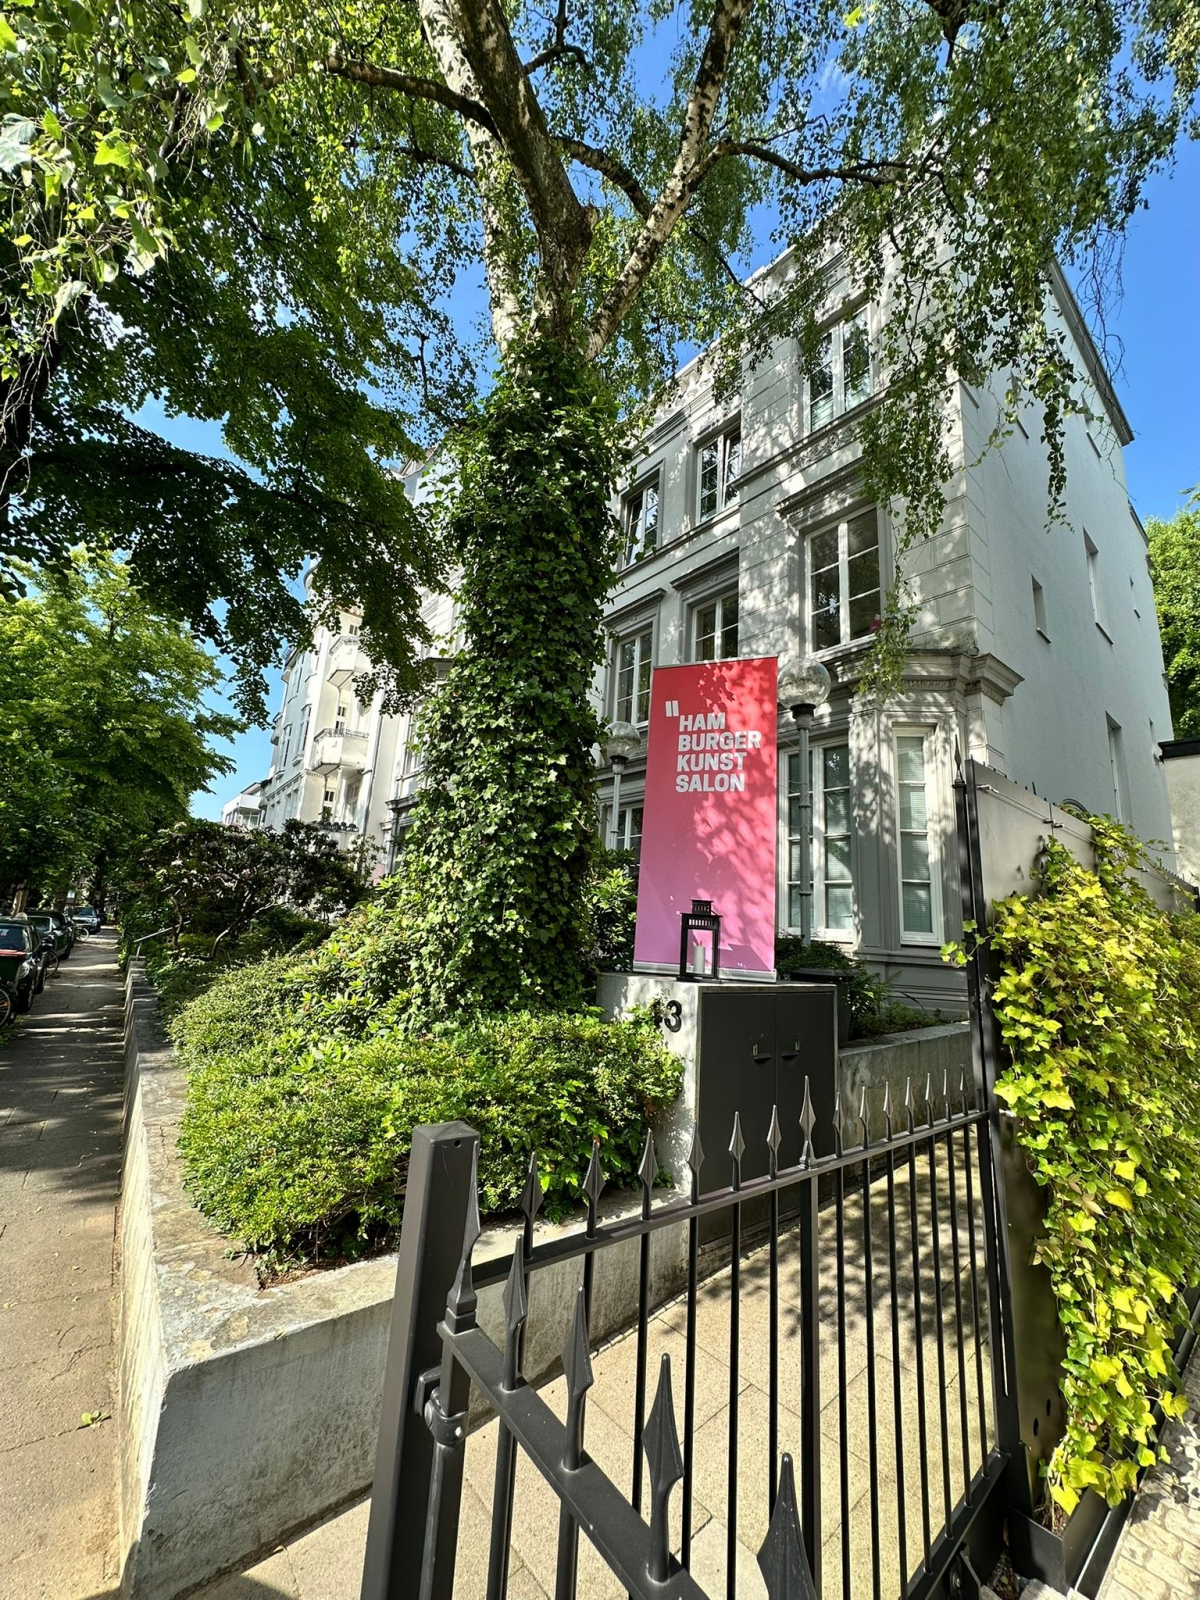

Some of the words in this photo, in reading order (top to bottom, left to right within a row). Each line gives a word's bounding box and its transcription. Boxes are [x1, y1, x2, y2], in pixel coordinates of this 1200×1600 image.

[678, 731, 762, 752] BURGER
[677, 752, 747, 772] KUNST
[675, 773, 745, 792] SALON
